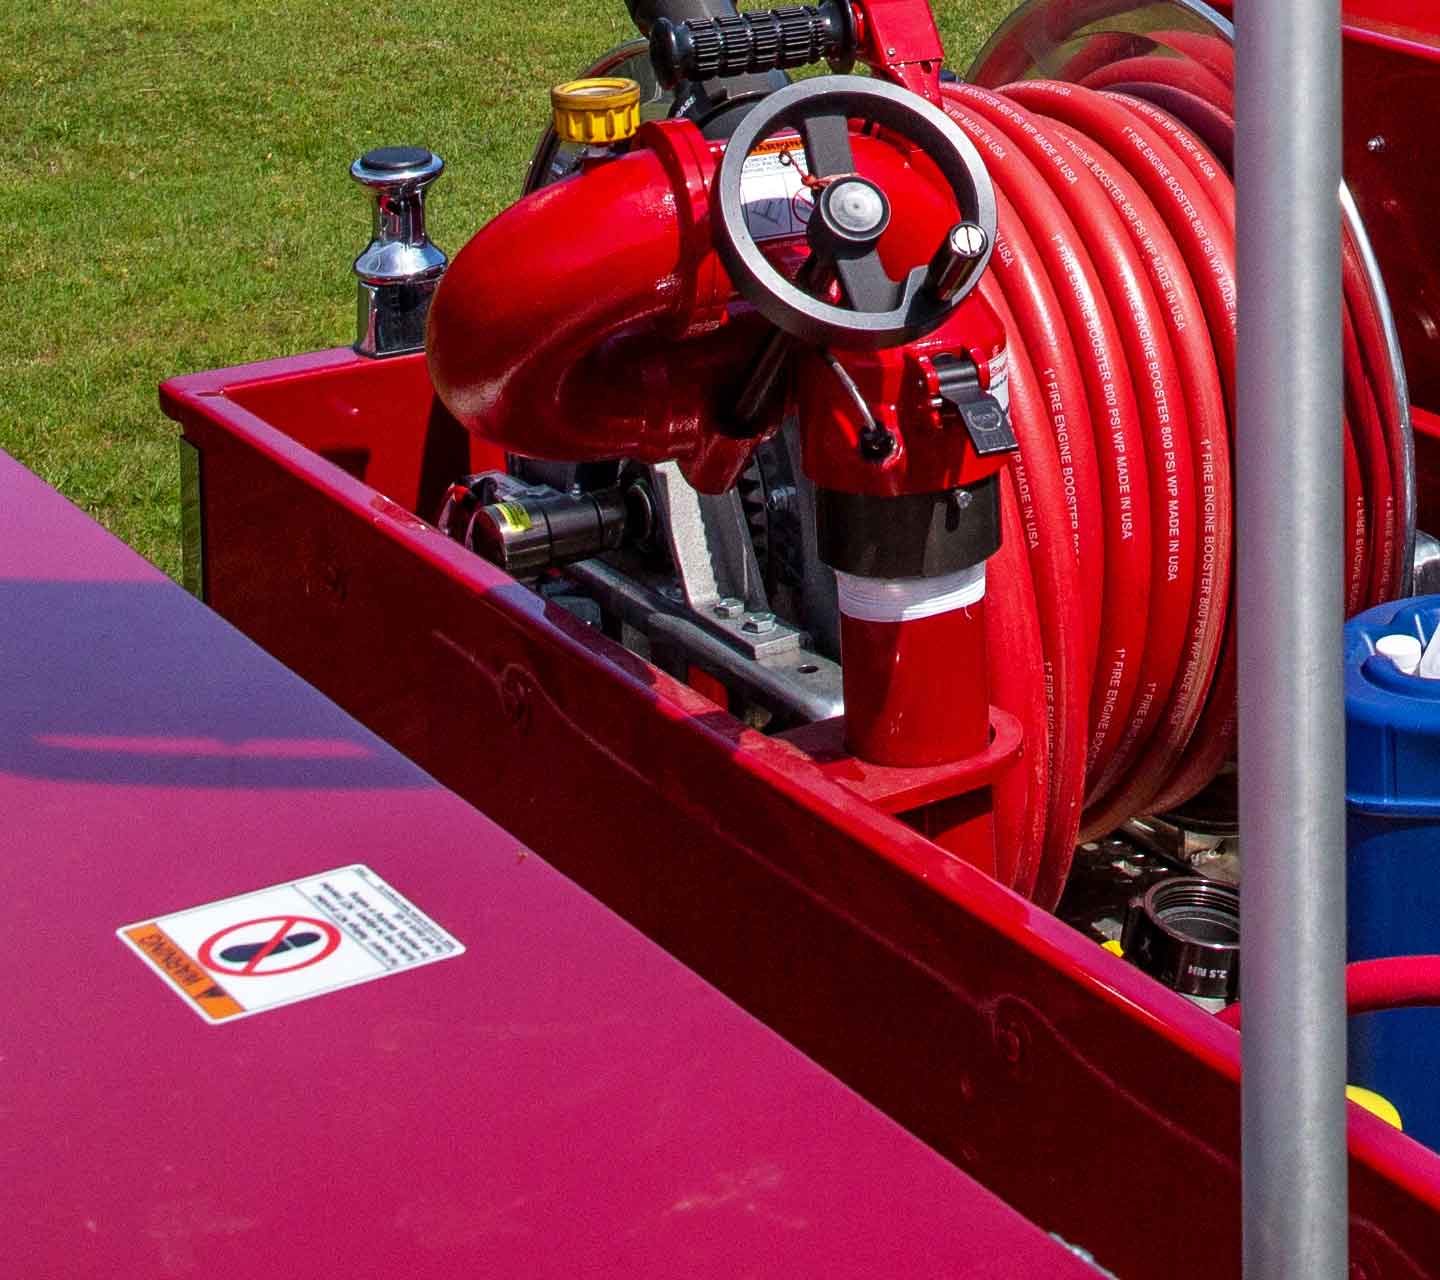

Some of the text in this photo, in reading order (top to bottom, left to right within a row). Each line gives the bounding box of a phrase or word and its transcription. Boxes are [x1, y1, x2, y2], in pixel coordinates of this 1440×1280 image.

[989, 141, 1006, 159] USA
[1174, 130, 1198, 153] MADE
[1034, 133, 1057, 156] MADE
[1053, 155, 1064, 167] IN
[1060, 164, 1078, 184] USA
[1192, 149, 1205, 163] IN
[1090, 159, 1126, 203] BOOSTER
[1198, 159, 1217, 181] USA
[1122, 202, 1138, 221] 800
[1127, 131, 1148, 152] FIRE
[1143, 147, 1170, 180] ENGINE
[1165, 175, 1198, 221] BOOSTER
[1192, 219, 1208, 239] 800
[1201, 238, 1217, 257] PSI
[1209, 255, 1225, 275] WP
[1217, 276, 1236, 311] MADE
[1133, 219, 1149, 240] PSI
[997, 241, 1015, 268] USA
[1056, 244, 1075, 273] FIRE
[1142, 236, 1158, 256] WP
[1151, 255, 1173, 290] MADE
[1069, 274, 1092, 320] ENGINE
[1167, 288, 1177, 305] IN
[1171, 305, 1187, 332] USA
[1134, 308, 1157, 360] ENGINE
[1086, 320, 1111, 381] BOOSTER
[1043, 367, 1057, 380] 1"
[1046, 381, 1064, 413] FIRE
[1103, 382, 1117, 407] 800
[1148, 360, 1170, 425] BOOSTER
[1108, 408, 1122, 430] PSI
[1054, 414, 1073, 465] ENGINE
[1111, 431, 1126, 453] WP
[1161, 426, 1173, 449] 800
[1115, 455, 1131, 494] MADE
[1164, 451, 1176, 472] PSI
[1201, 452, 1215, 483] FIRE
[1015, 465, 1032, 504] MADE
[1167, 474, 1178, 497] WP
[1024, 505, 1034, 520] IN
[1119, 496, 1132, 511] IN
[1203, 486, 1217, 533] ENGINE
[1120, 513, 1134, 541] USA
[1168, 499, 1180, 537] MADE
[1356, 509, 1366, 536] FIRE
[1026, 521, 1040, 551] USA
[1168, 539, 1179, 555] IN
[1168, 555, 1179, 582] USA
[1201, 536, 1216, 598] BOOSTER
[1352, 538, 1367, 582] ENGINE
[1198, 598, 1210, 618] 800
[1193, 619, 1208, 638] PSI
[1098, 647, 1126, 730] 1" FIRE ENGINE
[1136, 694, 1153, 717] FIRE
[140, 933, 202, 985] WARNING
